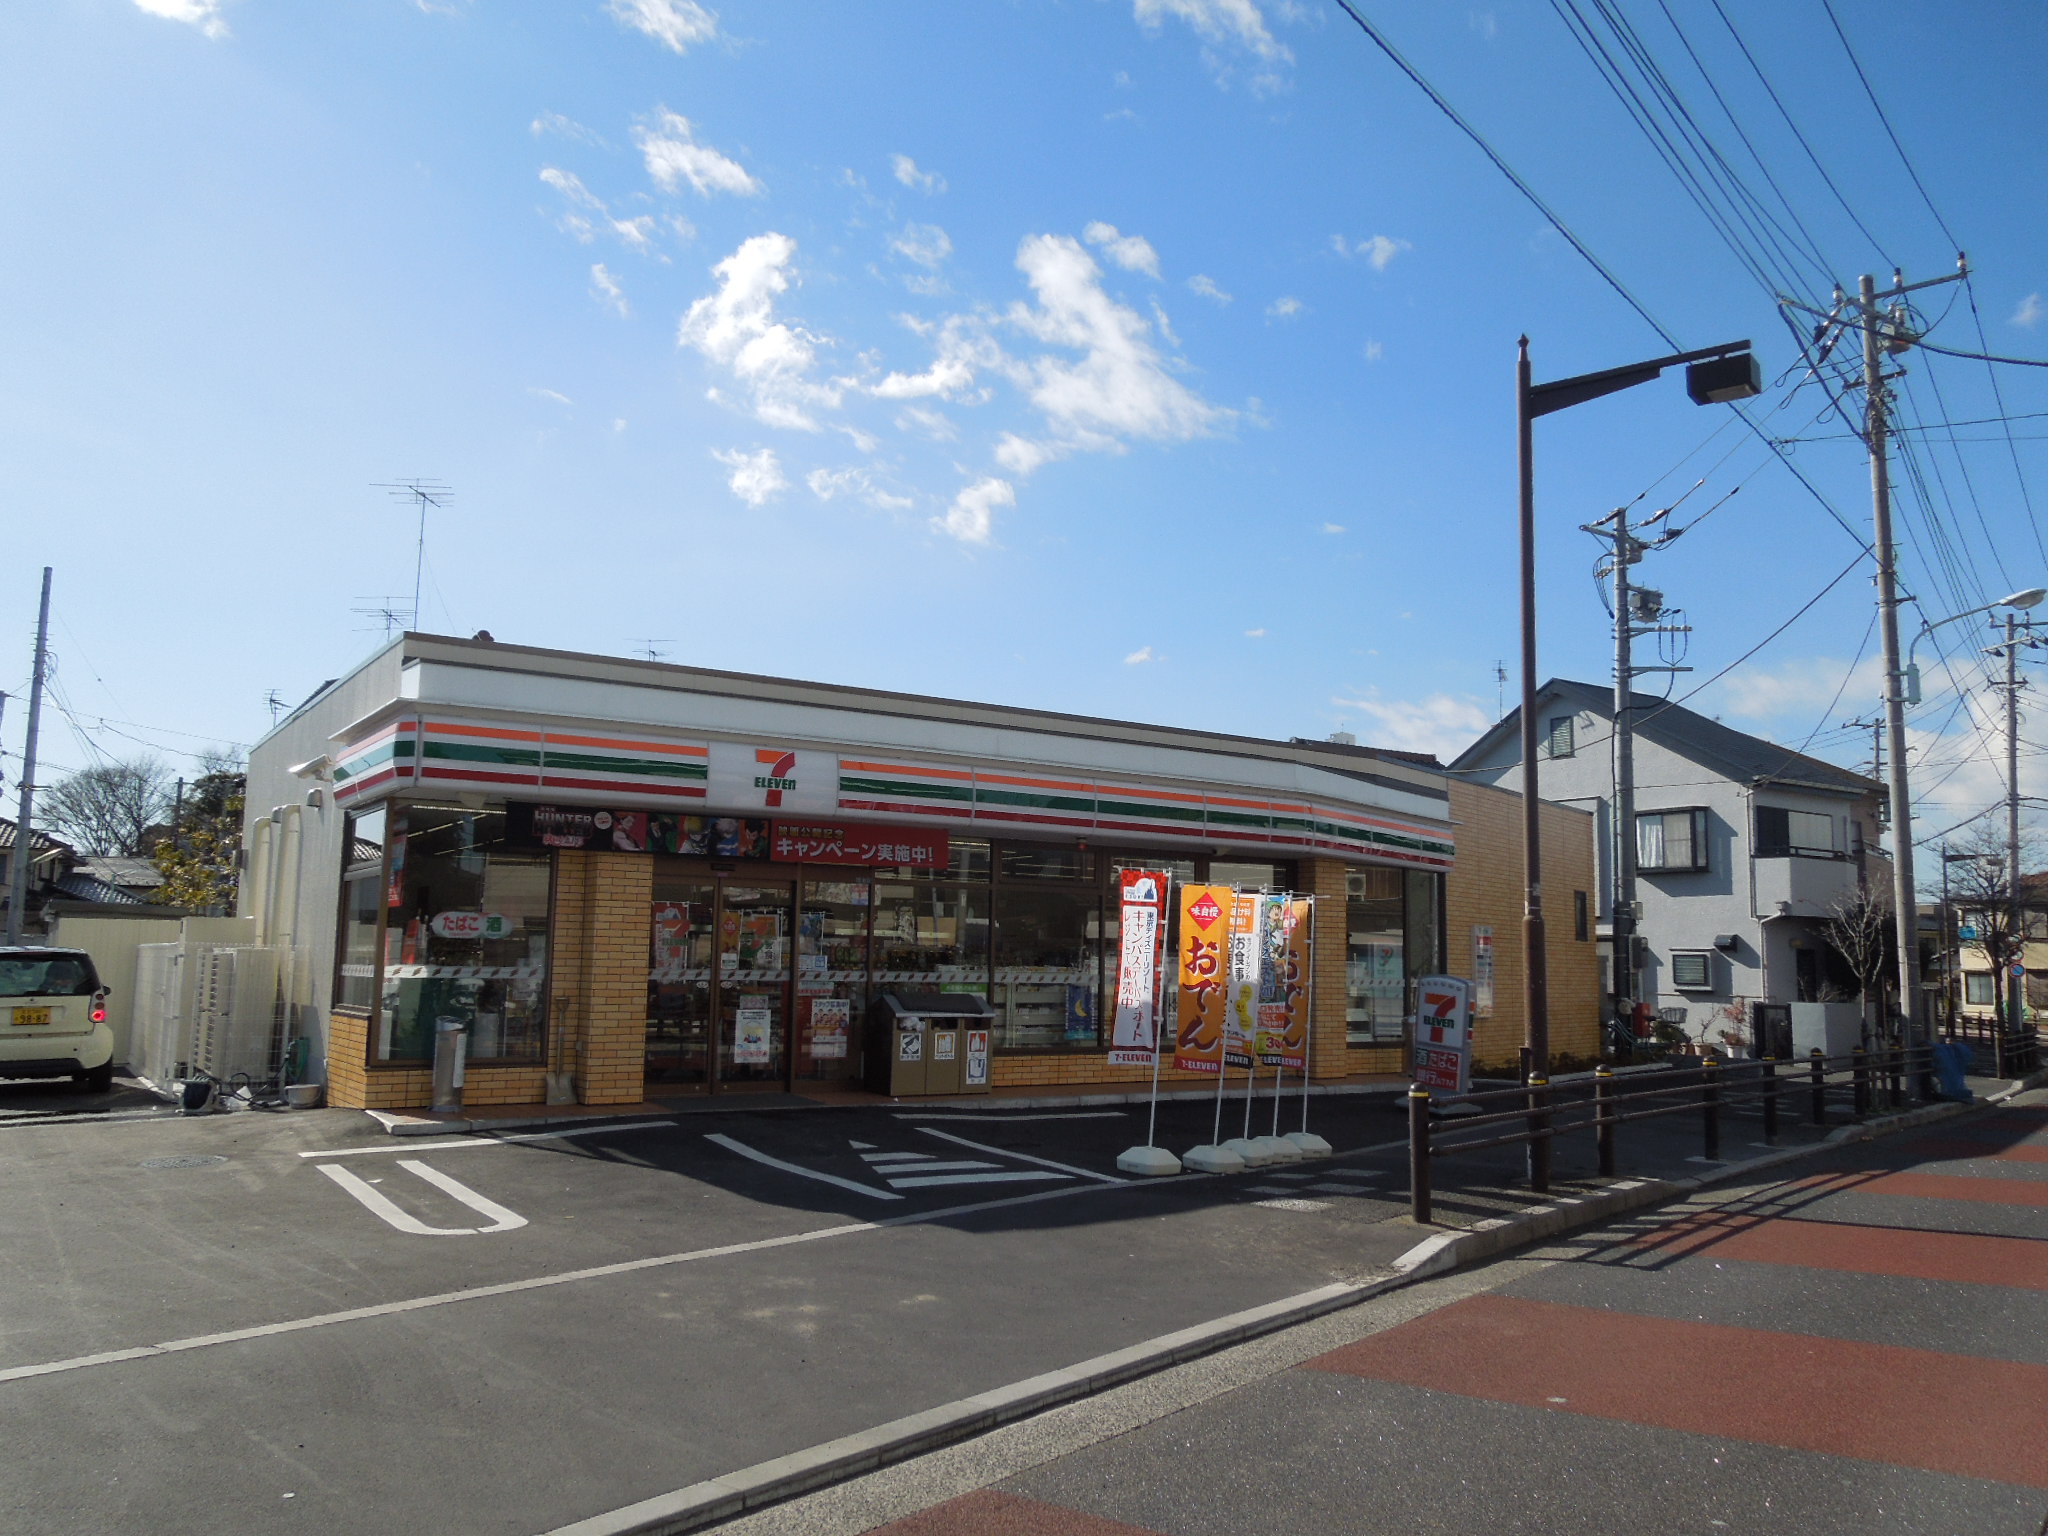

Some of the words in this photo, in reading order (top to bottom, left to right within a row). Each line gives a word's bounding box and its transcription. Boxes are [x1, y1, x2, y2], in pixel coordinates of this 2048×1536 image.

[1190, 906, 1219, 918] 味自慢
[442, 915, 480, 932] たばこ
[486, 916, 502, 932] 酒
[1234, 936, 1246, 982] お食事
[1178, 935, 1222, 1053] おでん
[1430, 1052, 1458, 1070] たばこ
